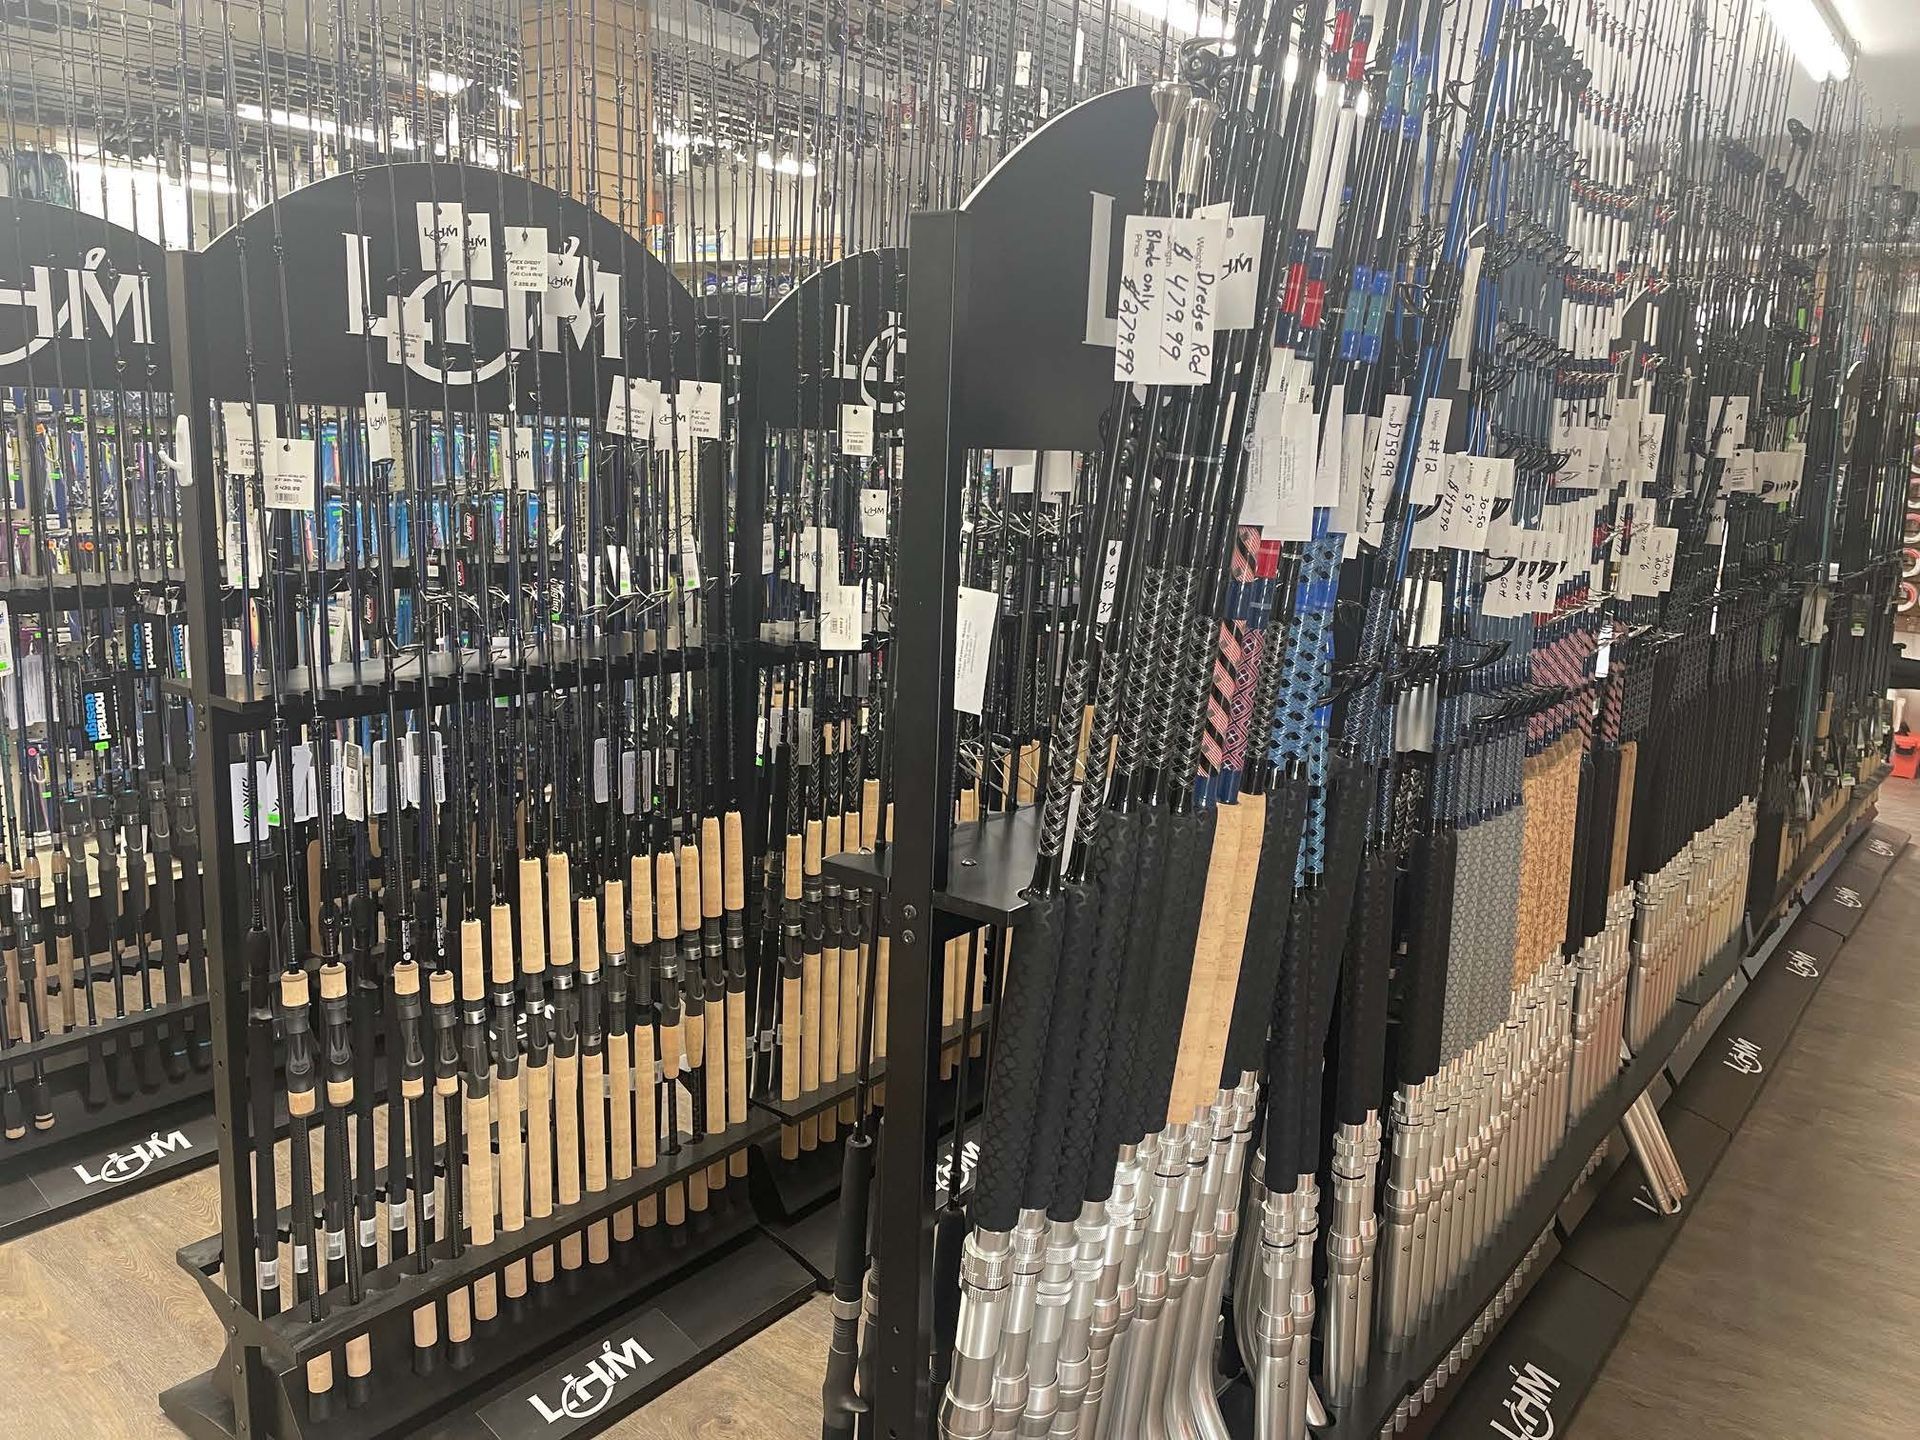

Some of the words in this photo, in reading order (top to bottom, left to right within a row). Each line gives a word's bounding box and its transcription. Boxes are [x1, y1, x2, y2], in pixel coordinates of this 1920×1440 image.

[1133, 233, 1144, 257] Price
[1145, 229, 1163, 267] Blade
[1138, 273, 1155, 311] only
[1159, 273, 1190, 361] 479.99
[1188, 343, 1211, 376] Rod
[1476, 496, 1490, 529] 30-50
[143, 621, 157, 670] nomad
[85, 692, 99, 742] design
[94, 691, 112, 741] nomad
